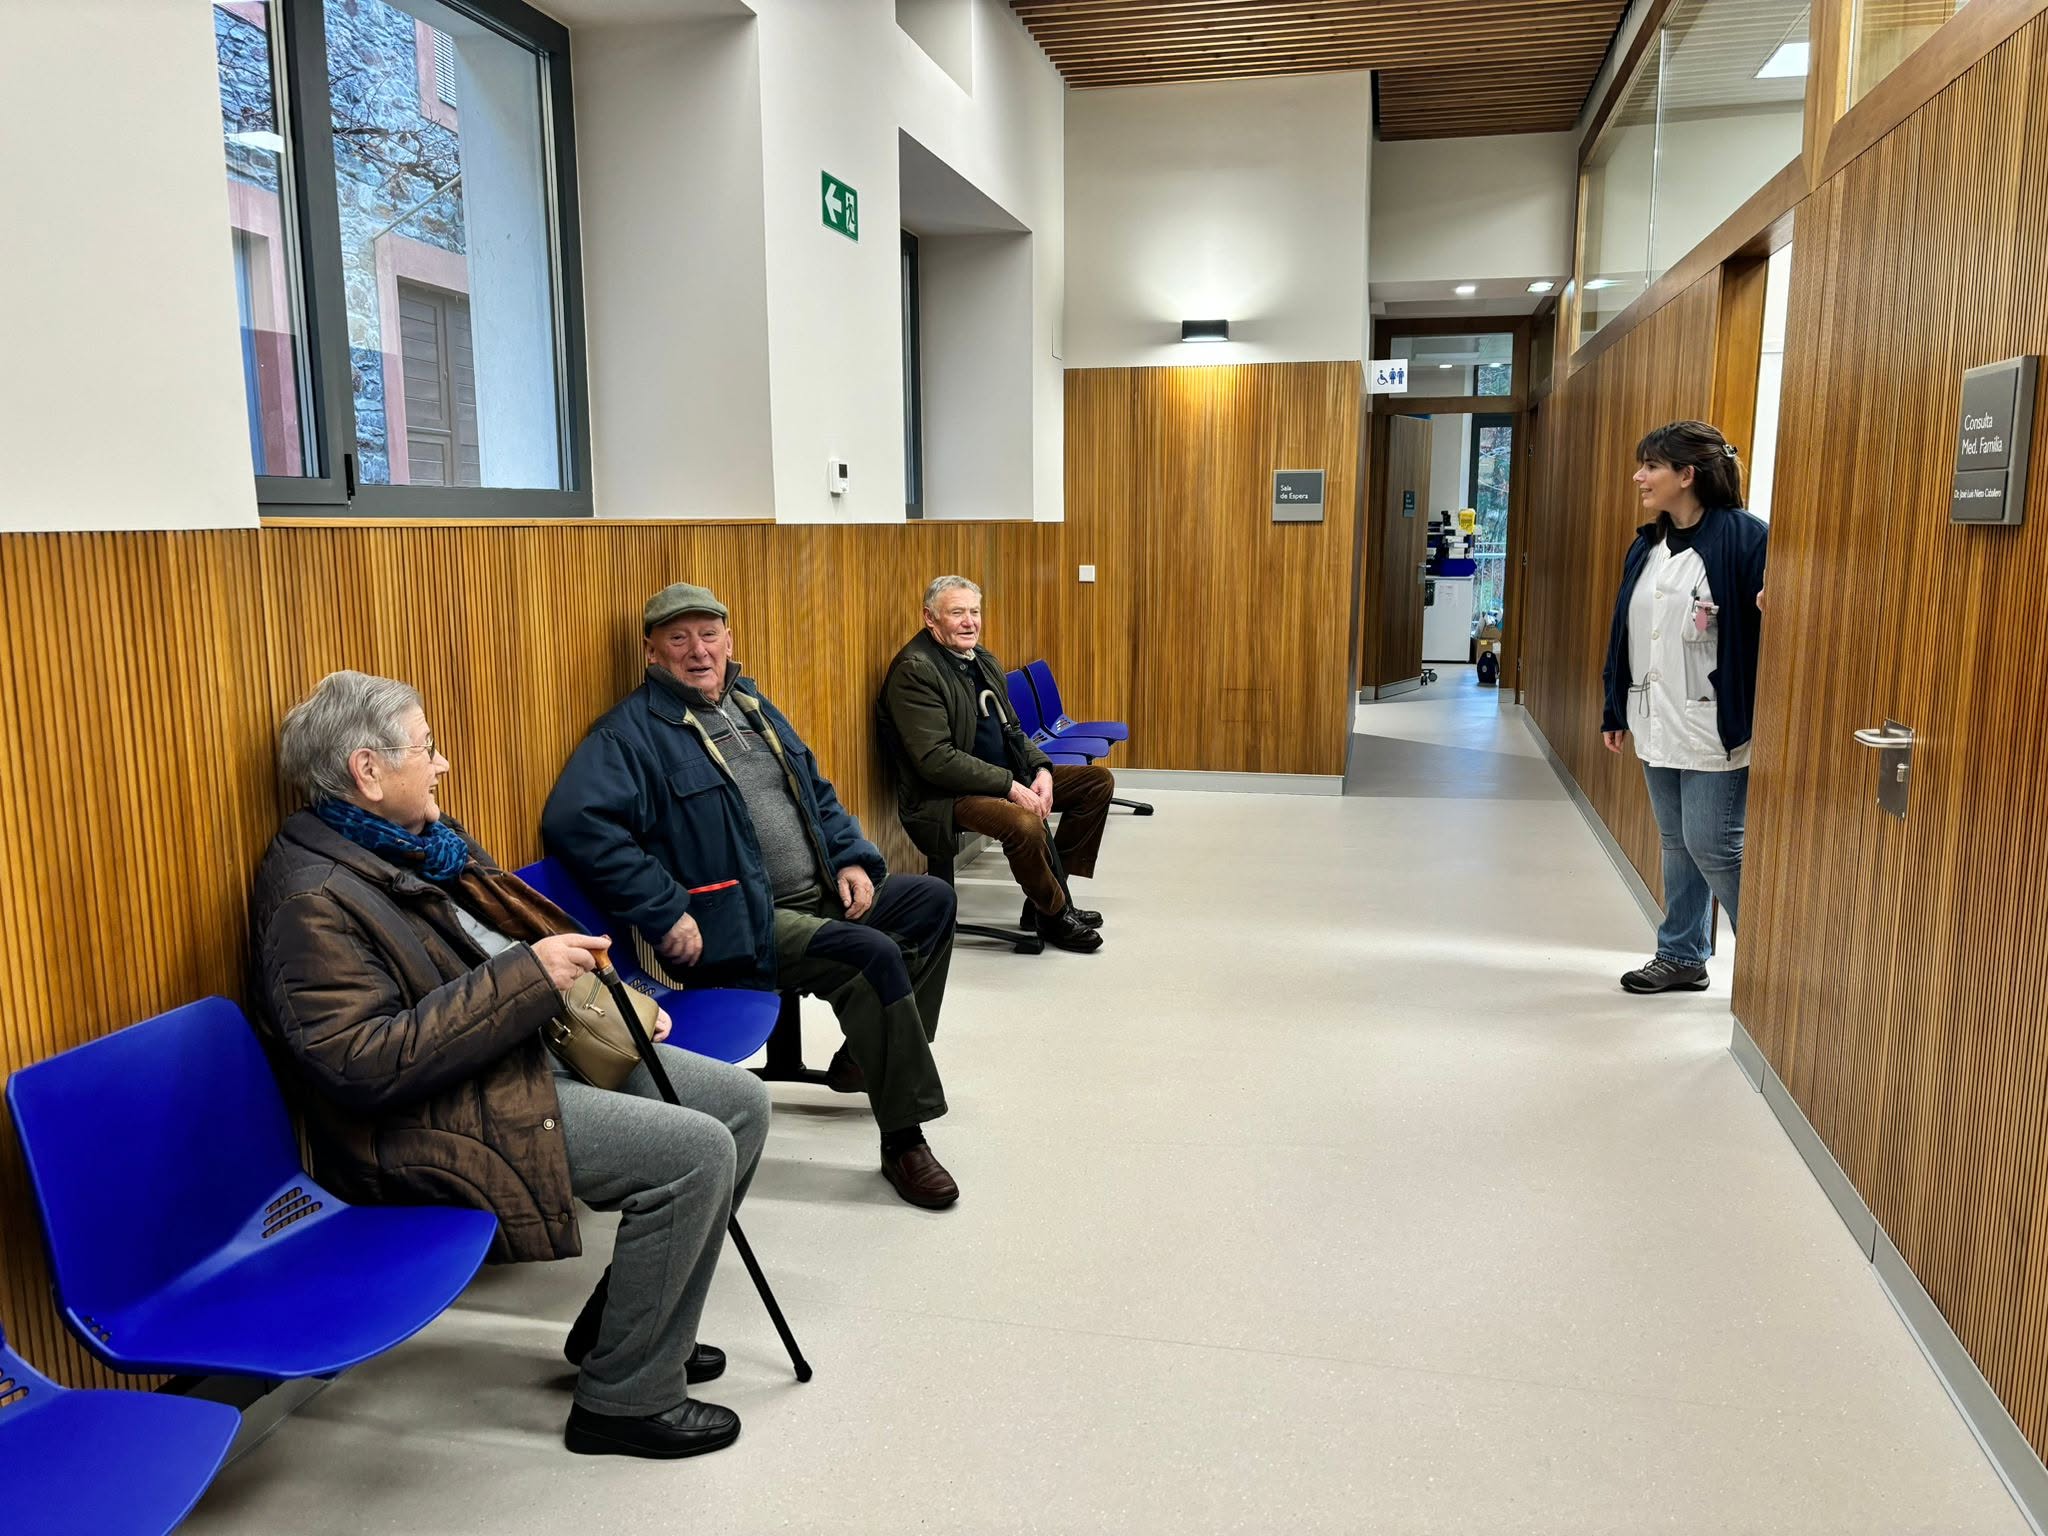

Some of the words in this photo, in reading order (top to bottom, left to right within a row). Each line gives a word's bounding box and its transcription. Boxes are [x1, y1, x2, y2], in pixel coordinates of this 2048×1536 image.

[1964, 412, 1993, 431] Consulta
[1961, 437, 1978, 455] Med.
[1288, 492, 1309, 500] Espera
